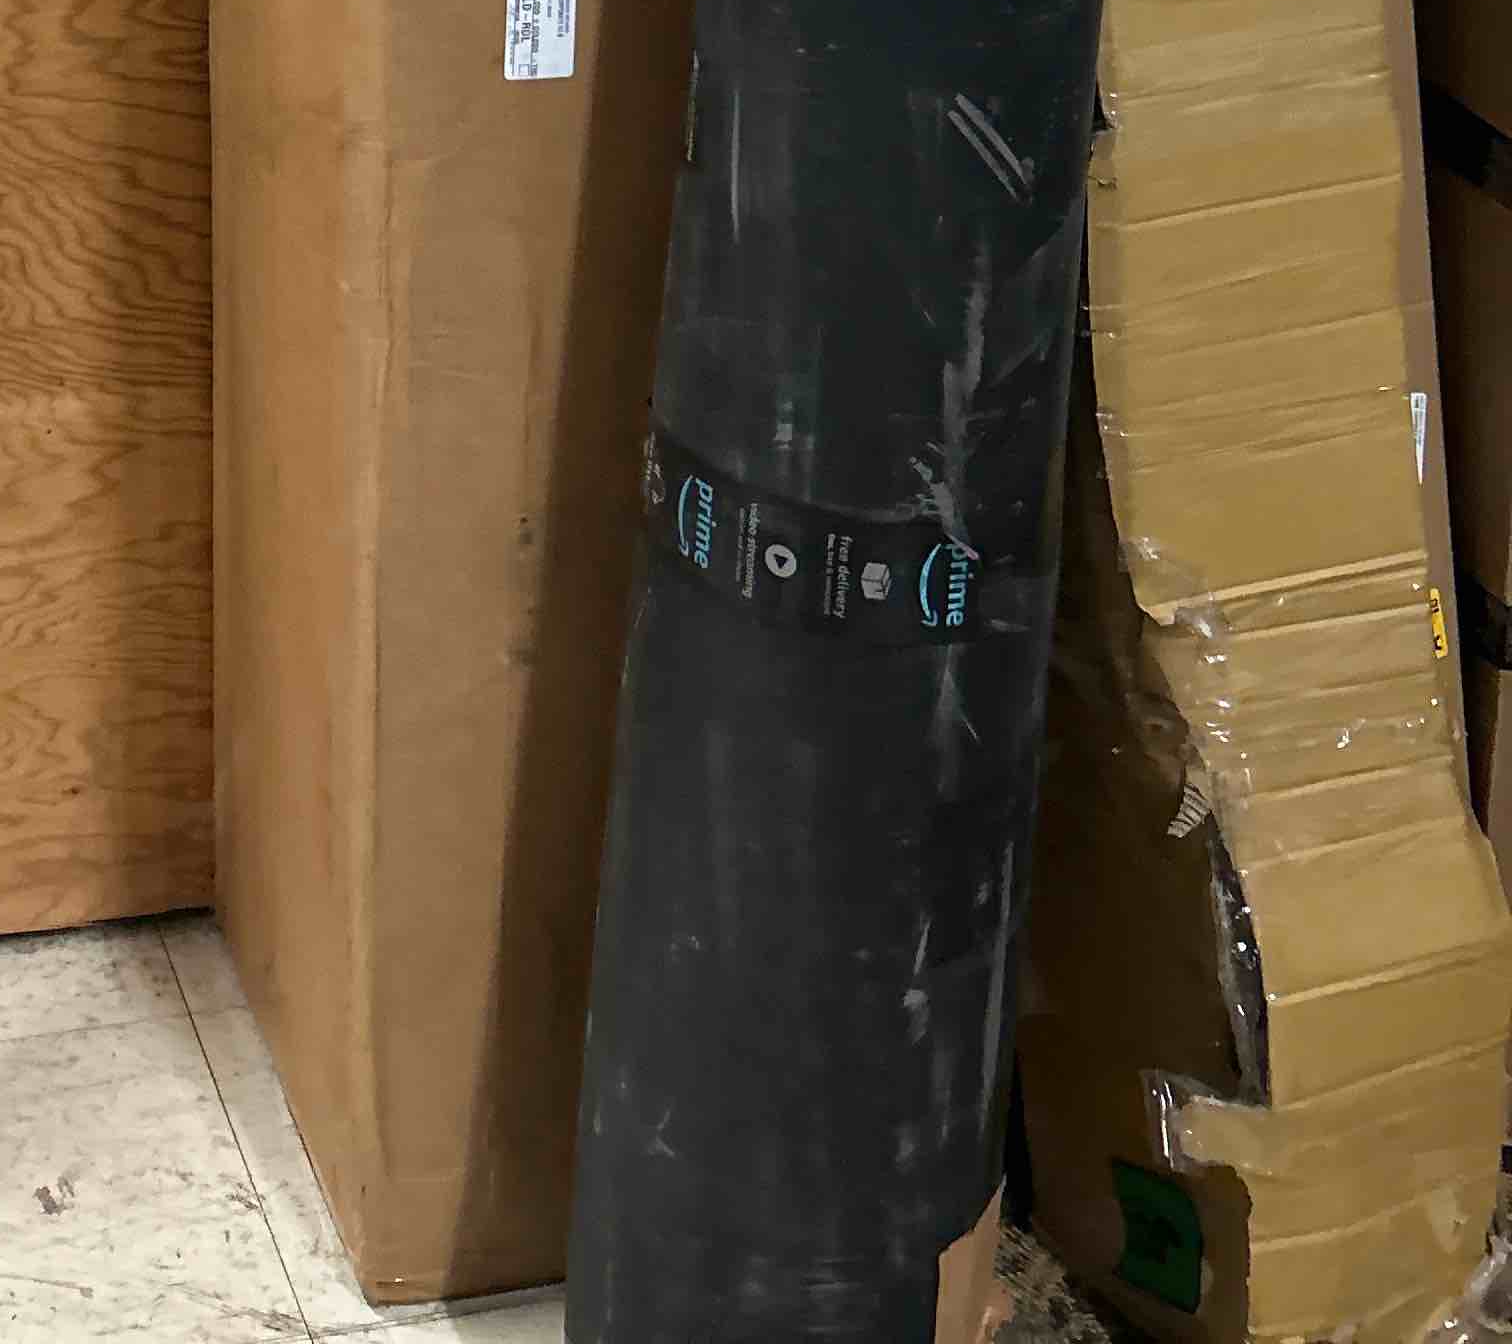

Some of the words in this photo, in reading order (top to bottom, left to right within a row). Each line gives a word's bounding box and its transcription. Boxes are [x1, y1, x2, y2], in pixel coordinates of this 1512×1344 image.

[693, 477, 720, 569] prime
[838, 535, 854, 562] free
[833, 564, 852, 619] delivery
[945, 541, 975, 627] prime
